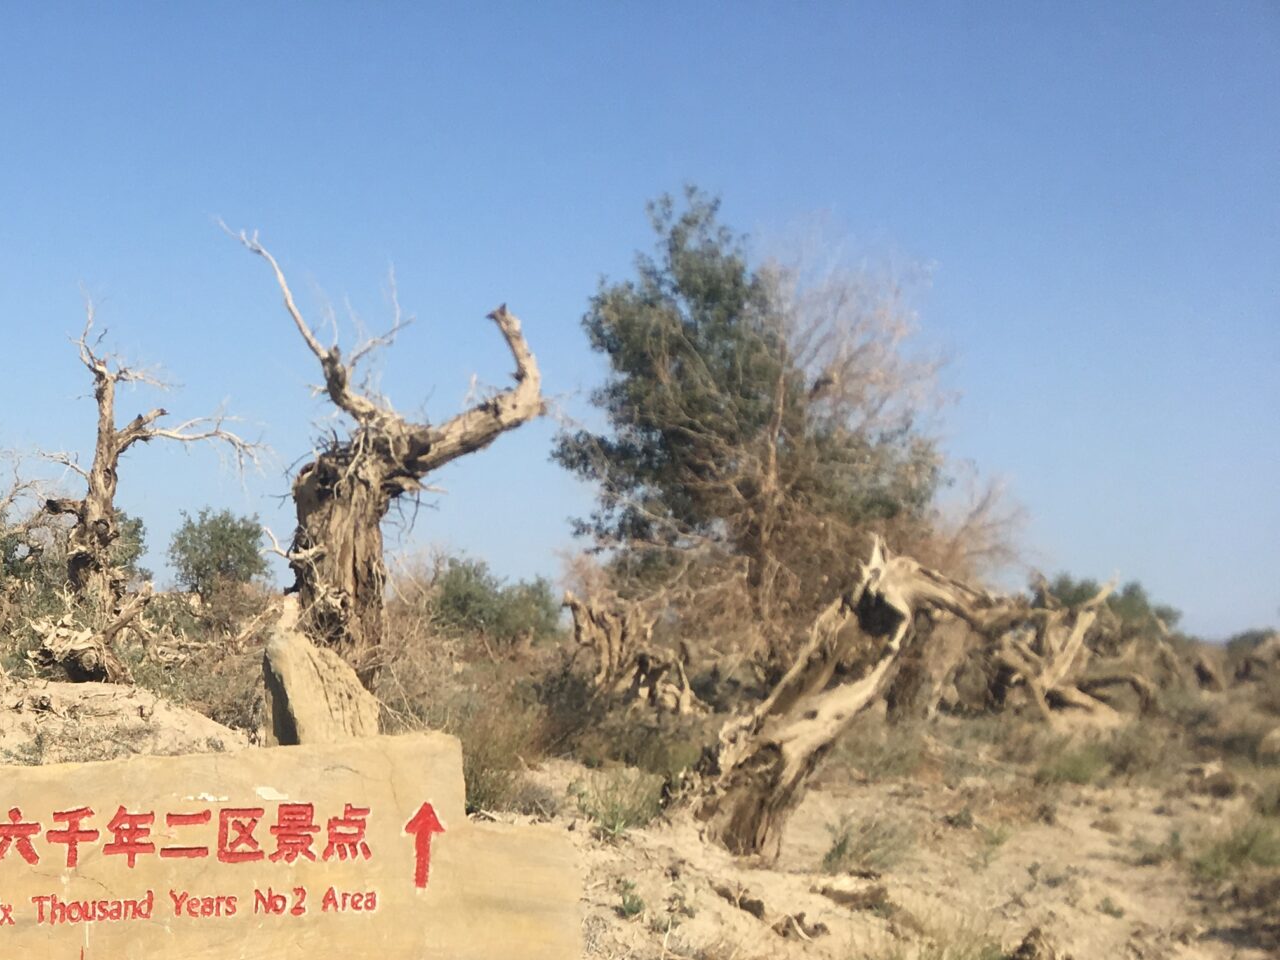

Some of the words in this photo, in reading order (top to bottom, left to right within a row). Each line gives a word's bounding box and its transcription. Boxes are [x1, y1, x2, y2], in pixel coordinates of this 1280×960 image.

[31, 889, 156, 926] Thousand
[168, 889, 238, 918] Years
[321, 886, 377, 913] Area
